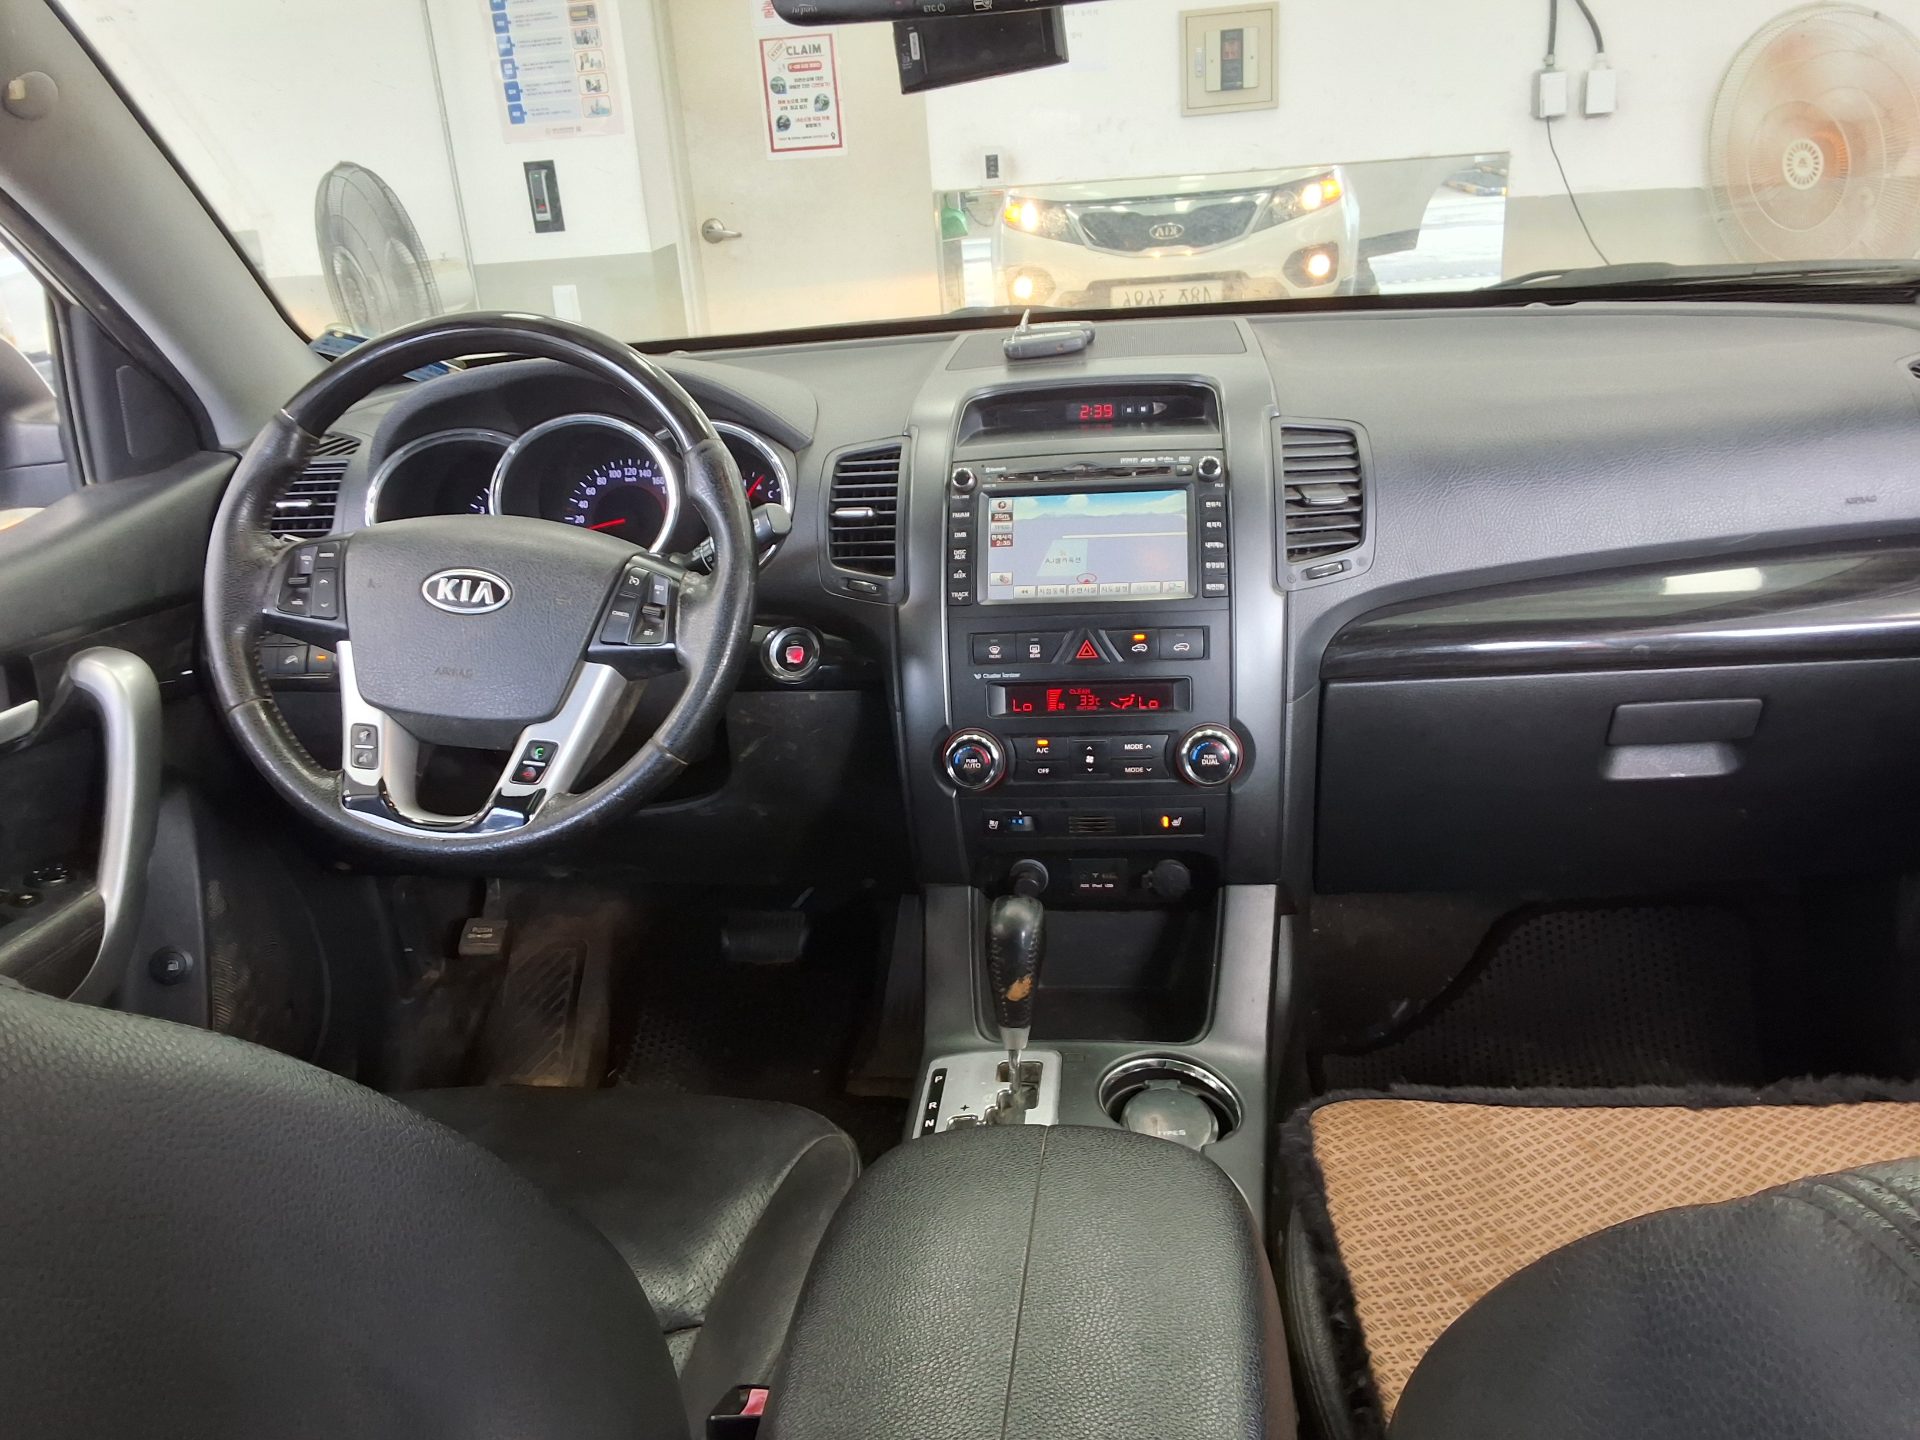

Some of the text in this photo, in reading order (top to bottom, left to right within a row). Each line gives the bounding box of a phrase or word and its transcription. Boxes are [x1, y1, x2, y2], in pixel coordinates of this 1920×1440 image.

[923, 4, 937, 12] ETC
[786, 43, 822, 56] CLAIM
[1080, 404, 1113, 418] 2:39
[609, 470, 622, 478] 100
[624, 468, 637, 476] 120
[639, 469, 652, 477] 140
[596, 477, 607, 485] 80
[653, 476, 665, 485] 160
[586, 487, 596, 495] 60
[578, 500, 589, 508] 40
[575, 515, 585, 523] 20
[436, 578, 494, 605] KIA
[1013, 699, 1032, 711] Lo
[1138, 696, 1160, 709] Lo
[925, 1119, 934, 1127] N
